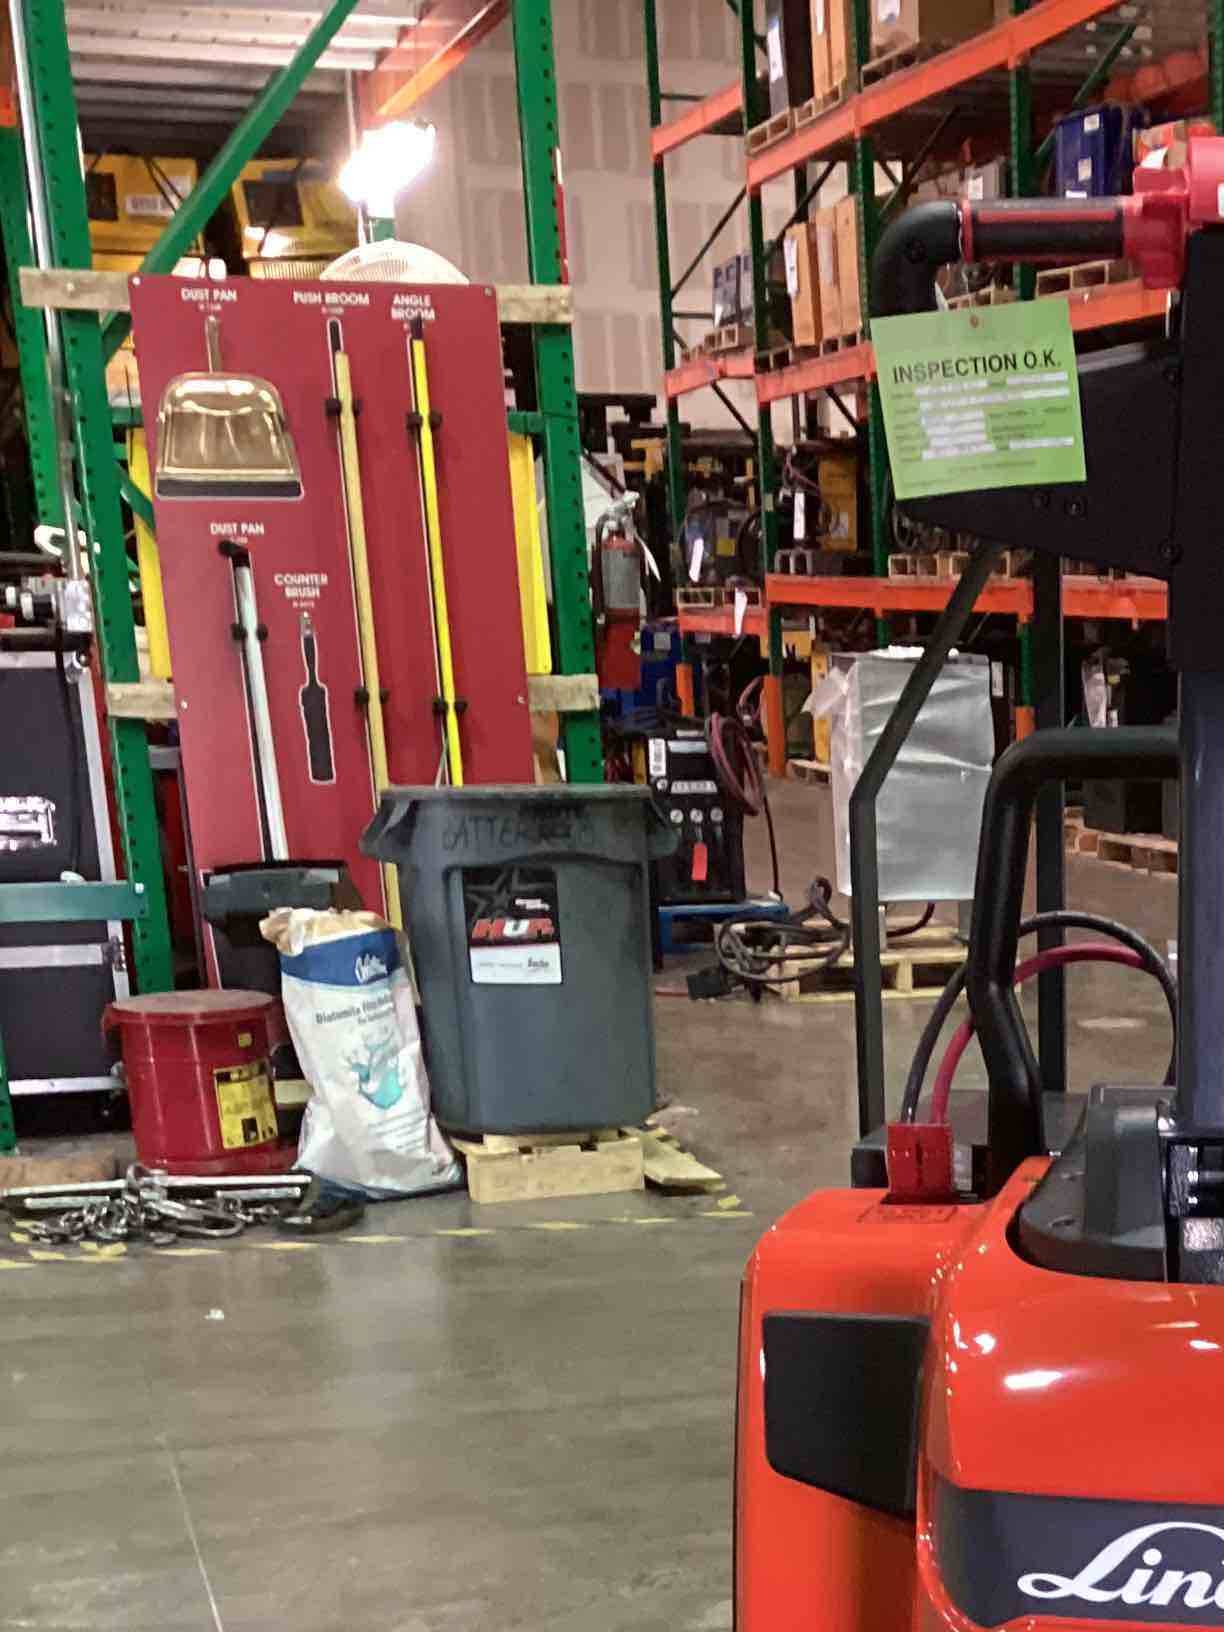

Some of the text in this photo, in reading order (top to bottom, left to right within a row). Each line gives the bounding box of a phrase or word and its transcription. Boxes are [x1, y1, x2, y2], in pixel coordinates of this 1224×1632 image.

[181, 288, 237, 302] DUST PAN
[293, 291, 369, 305] PUSH BROOM
[393, 294, 431, 306] ANGLE
[391, 307, 435, 320] BROOM
[892, 349, 1062, 384] INSPECTION O.K.
[210, 522, 264, 535] DUST PAN
[273, 573, 328, 585] COUNTER
[285, 587, 320, 598] BRUSH
